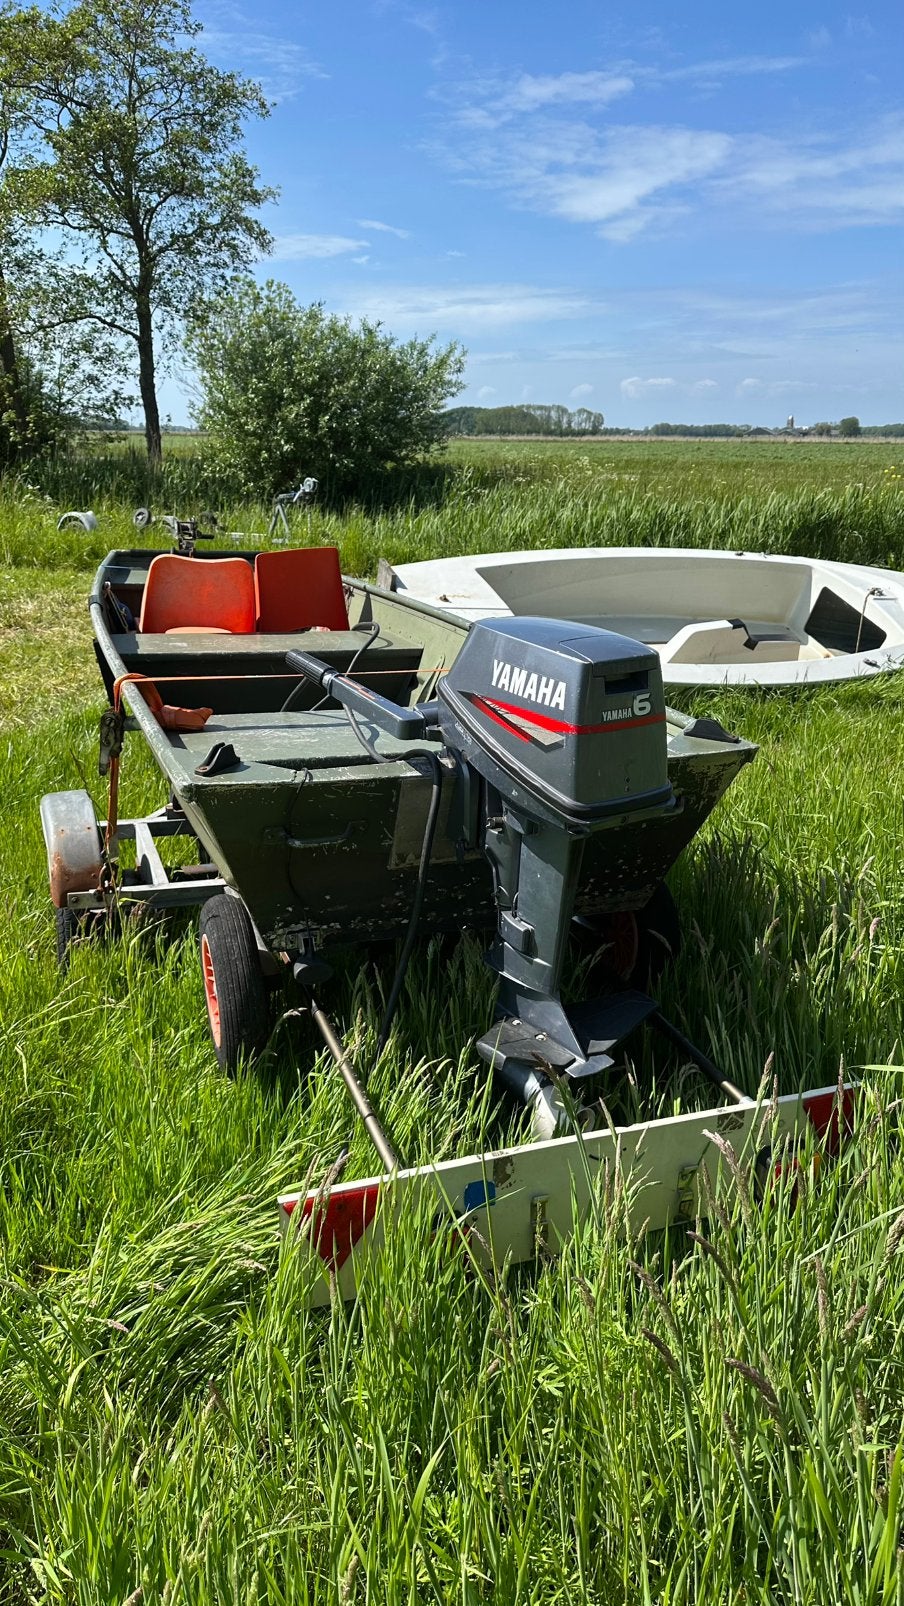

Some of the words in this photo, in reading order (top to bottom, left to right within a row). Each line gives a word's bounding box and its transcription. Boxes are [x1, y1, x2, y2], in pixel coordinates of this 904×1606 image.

[491, 659, 567, 711] YAMAHA
[602, 707, 633, 722] YAMAHA
[633, 692, 651, 716] 6
